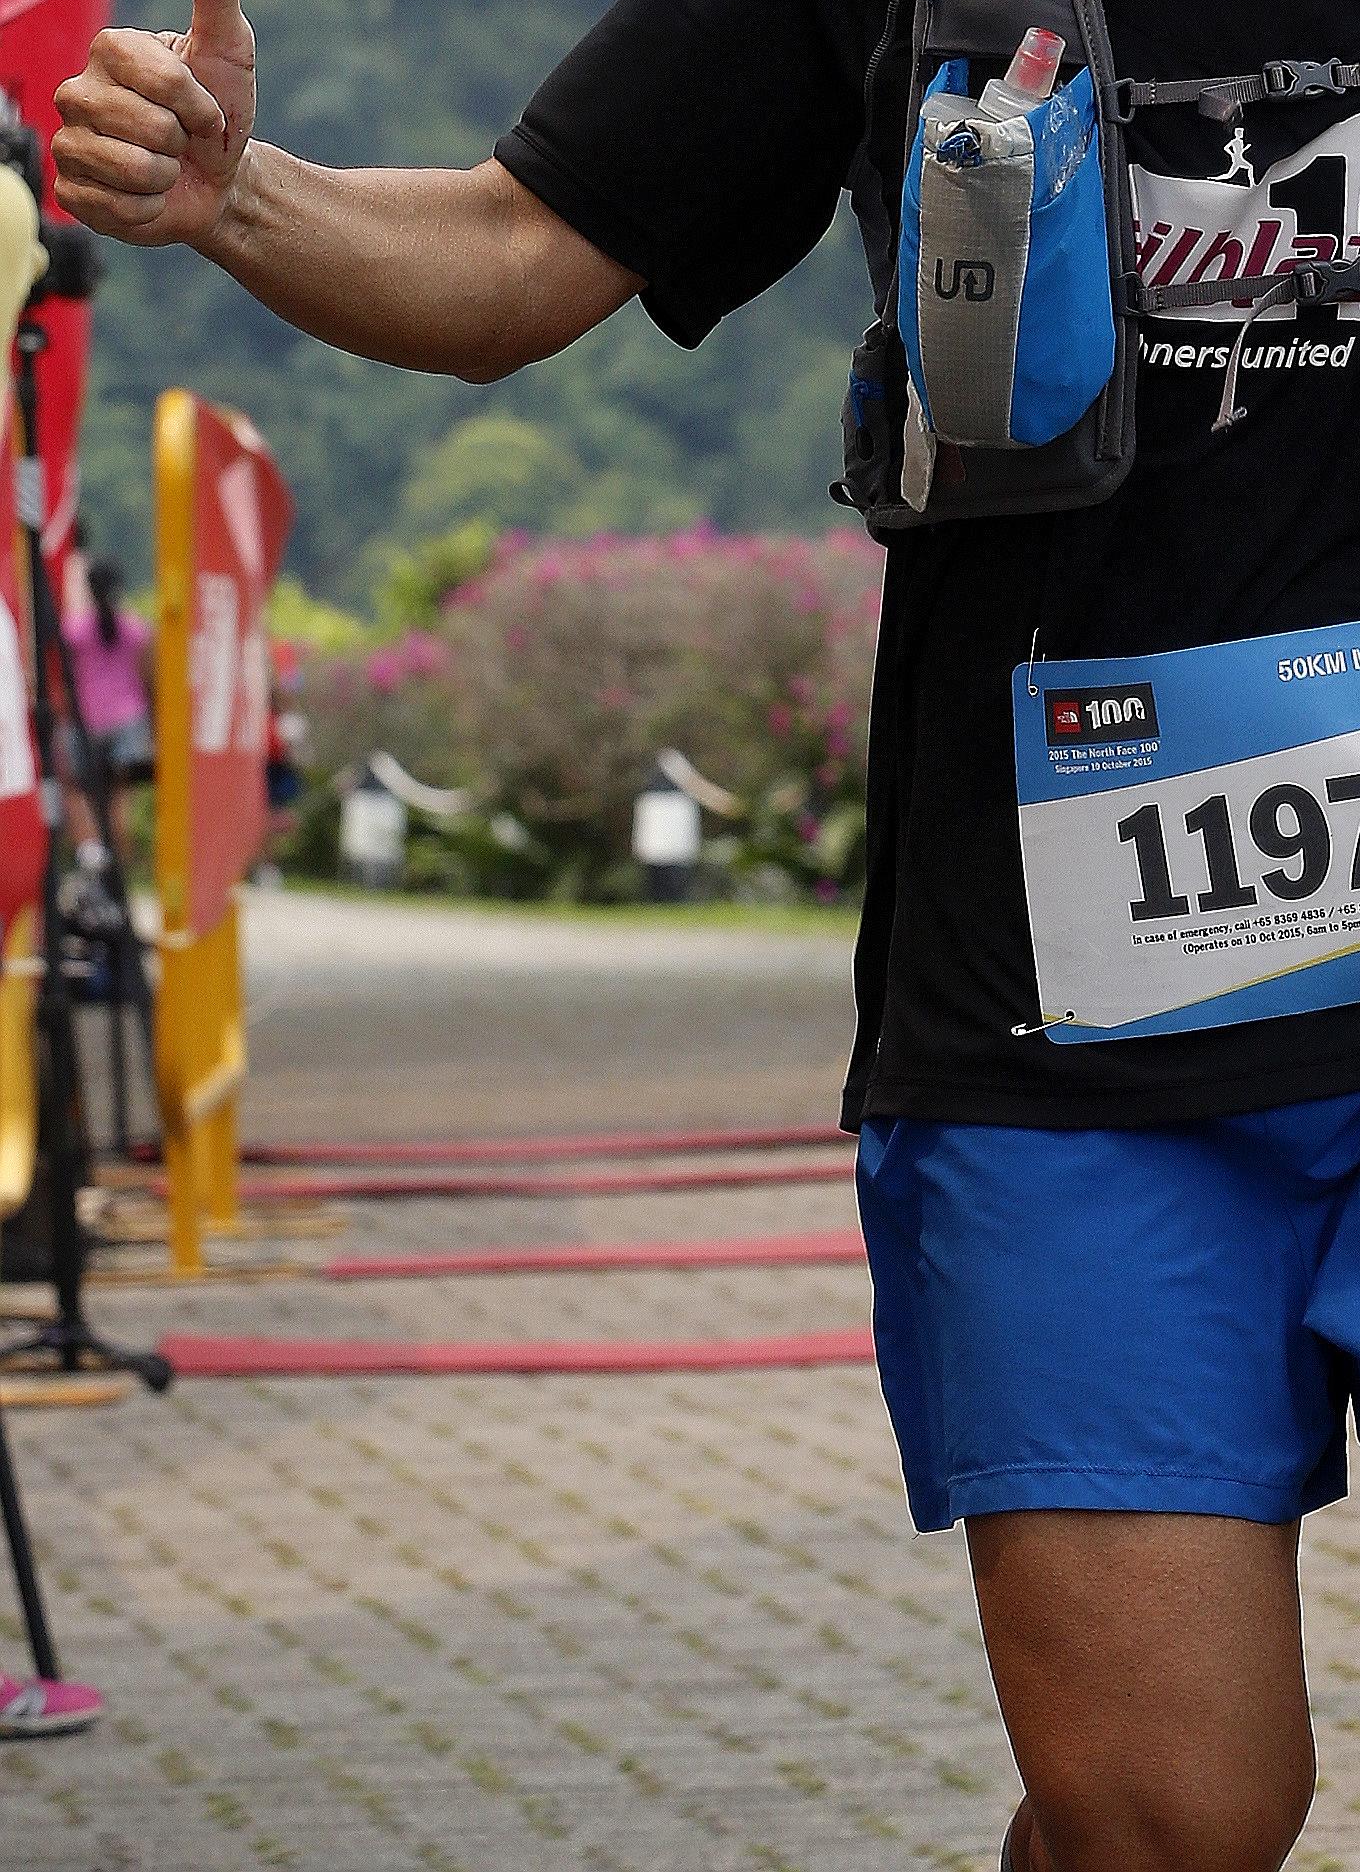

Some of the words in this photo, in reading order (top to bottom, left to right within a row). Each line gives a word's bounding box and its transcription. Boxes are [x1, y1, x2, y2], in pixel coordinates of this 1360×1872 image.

[1241, 336, 1356, 369] united
[1277, 650, 1348, 682] 50KM
[1085, 697, 1146, 730] 100
[1048, 749, 1069, 761] 2015
[1071, 748, 1087, 760] The
[1089, 746, 1115, 758] North
[1117, 745, 1137, 756] Face
[1140, 741, 1158, 752] 100
[1091, 762, 1100, 771] 10
[1102, 760, 1131, 771] October
[1133, 756, 1153, 767] 2015
[1145, 934, 1165, 943] case
[1167, 930, 1177, 940] of
[1180, 924, 1233, 939] emergency,
[1235, 920, 1250, 931] call
[1252, 916, 1272, 927] +65
[1274, 913, 1298, 924] 8369
[1301, 909, 1326, 920] 4836
[1337, 904, 1356, 915] +65
[1183, 939, 1229, 954] (Operates
[1231, 938, 1242, 946] on
[1245, 935, 1256, 945] 10
[1259, 932, 1275, 942] Oct
[1278, 929, 1304, 940] 2015,
[1307, 925, 1327, 935] 6am
[1329, 922, 1338, 932] to
